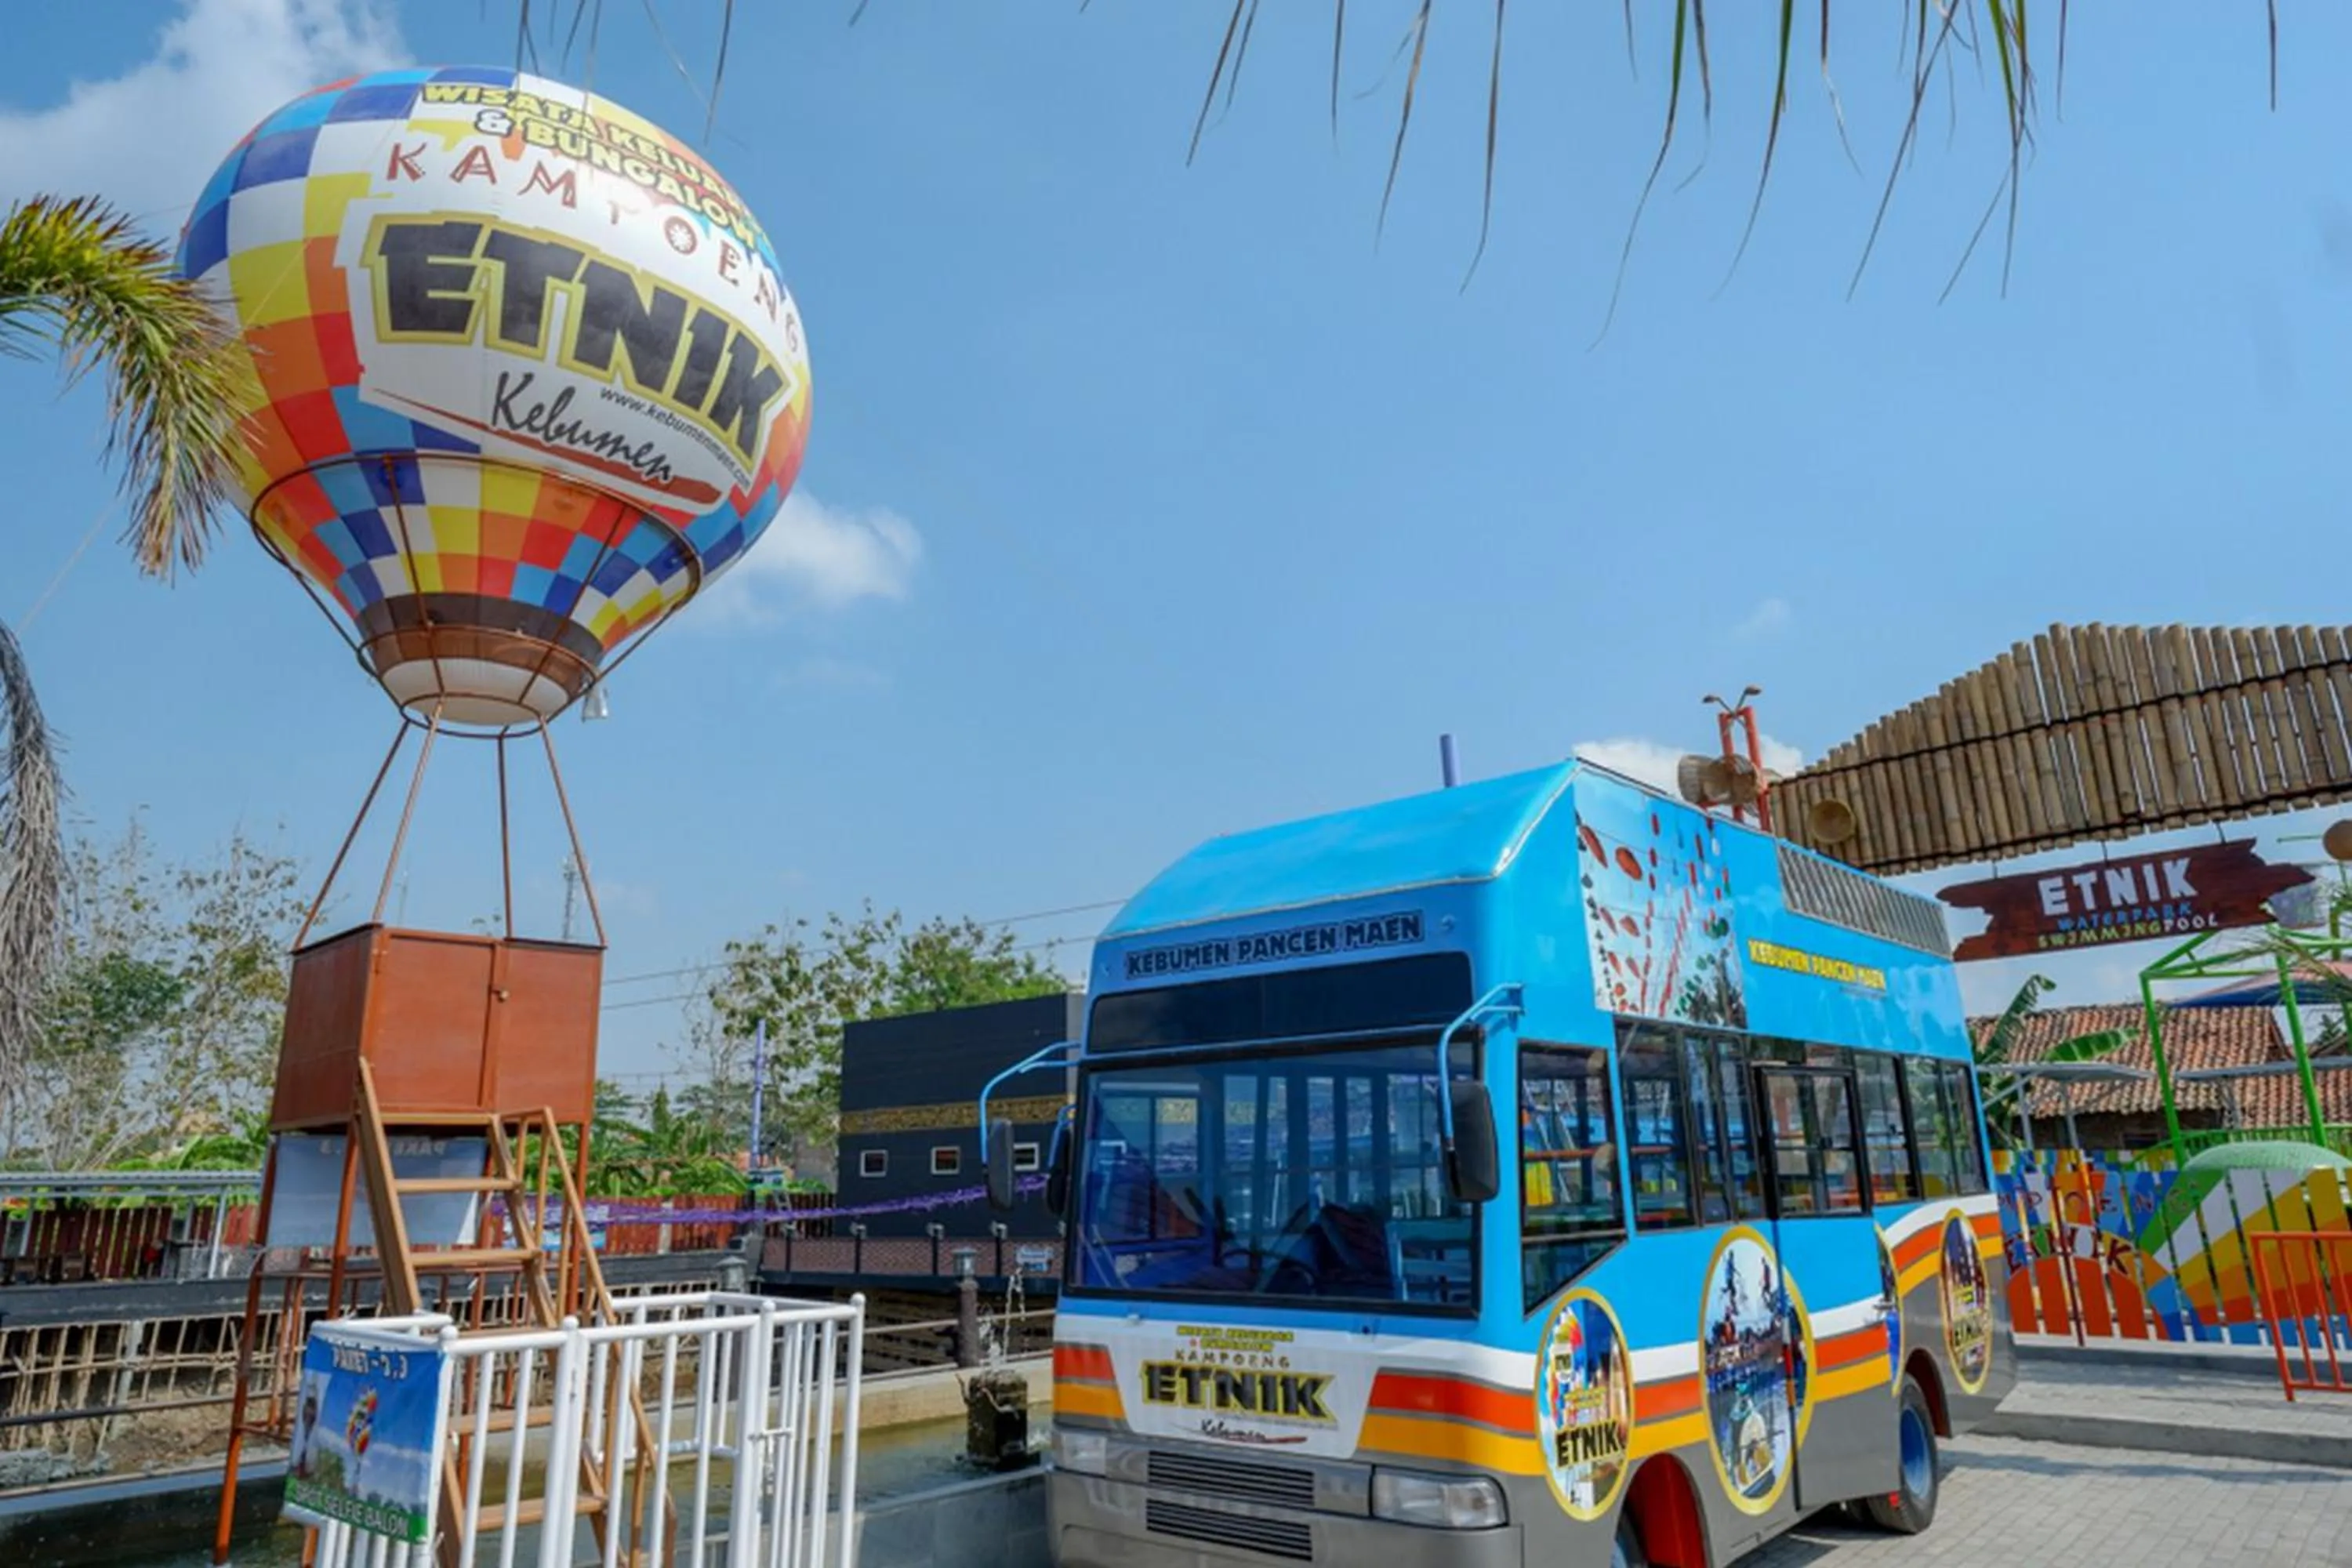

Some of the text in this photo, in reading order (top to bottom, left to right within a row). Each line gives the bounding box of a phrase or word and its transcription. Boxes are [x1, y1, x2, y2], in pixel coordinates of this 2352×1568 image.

[423, 85, 599, 141] WISATA
[475, 108, 514, 137] &
[368, 213, 788, 467] ETNIK
[492, 371, 673, 481] Kebumen
[2038, 858, 2198, 916] ETNIK
[1127, 914, 1421, 976] KEBUMEN PANCEN MAEN
[2057, 902, 2191, 931] WATERPARK
[1175, 1348, 1290, 1368] KAMPOENG
[1142, 1360, 1333, 1421] ETNIK
[1555, 1420, 1621, 1468] ETNIK
